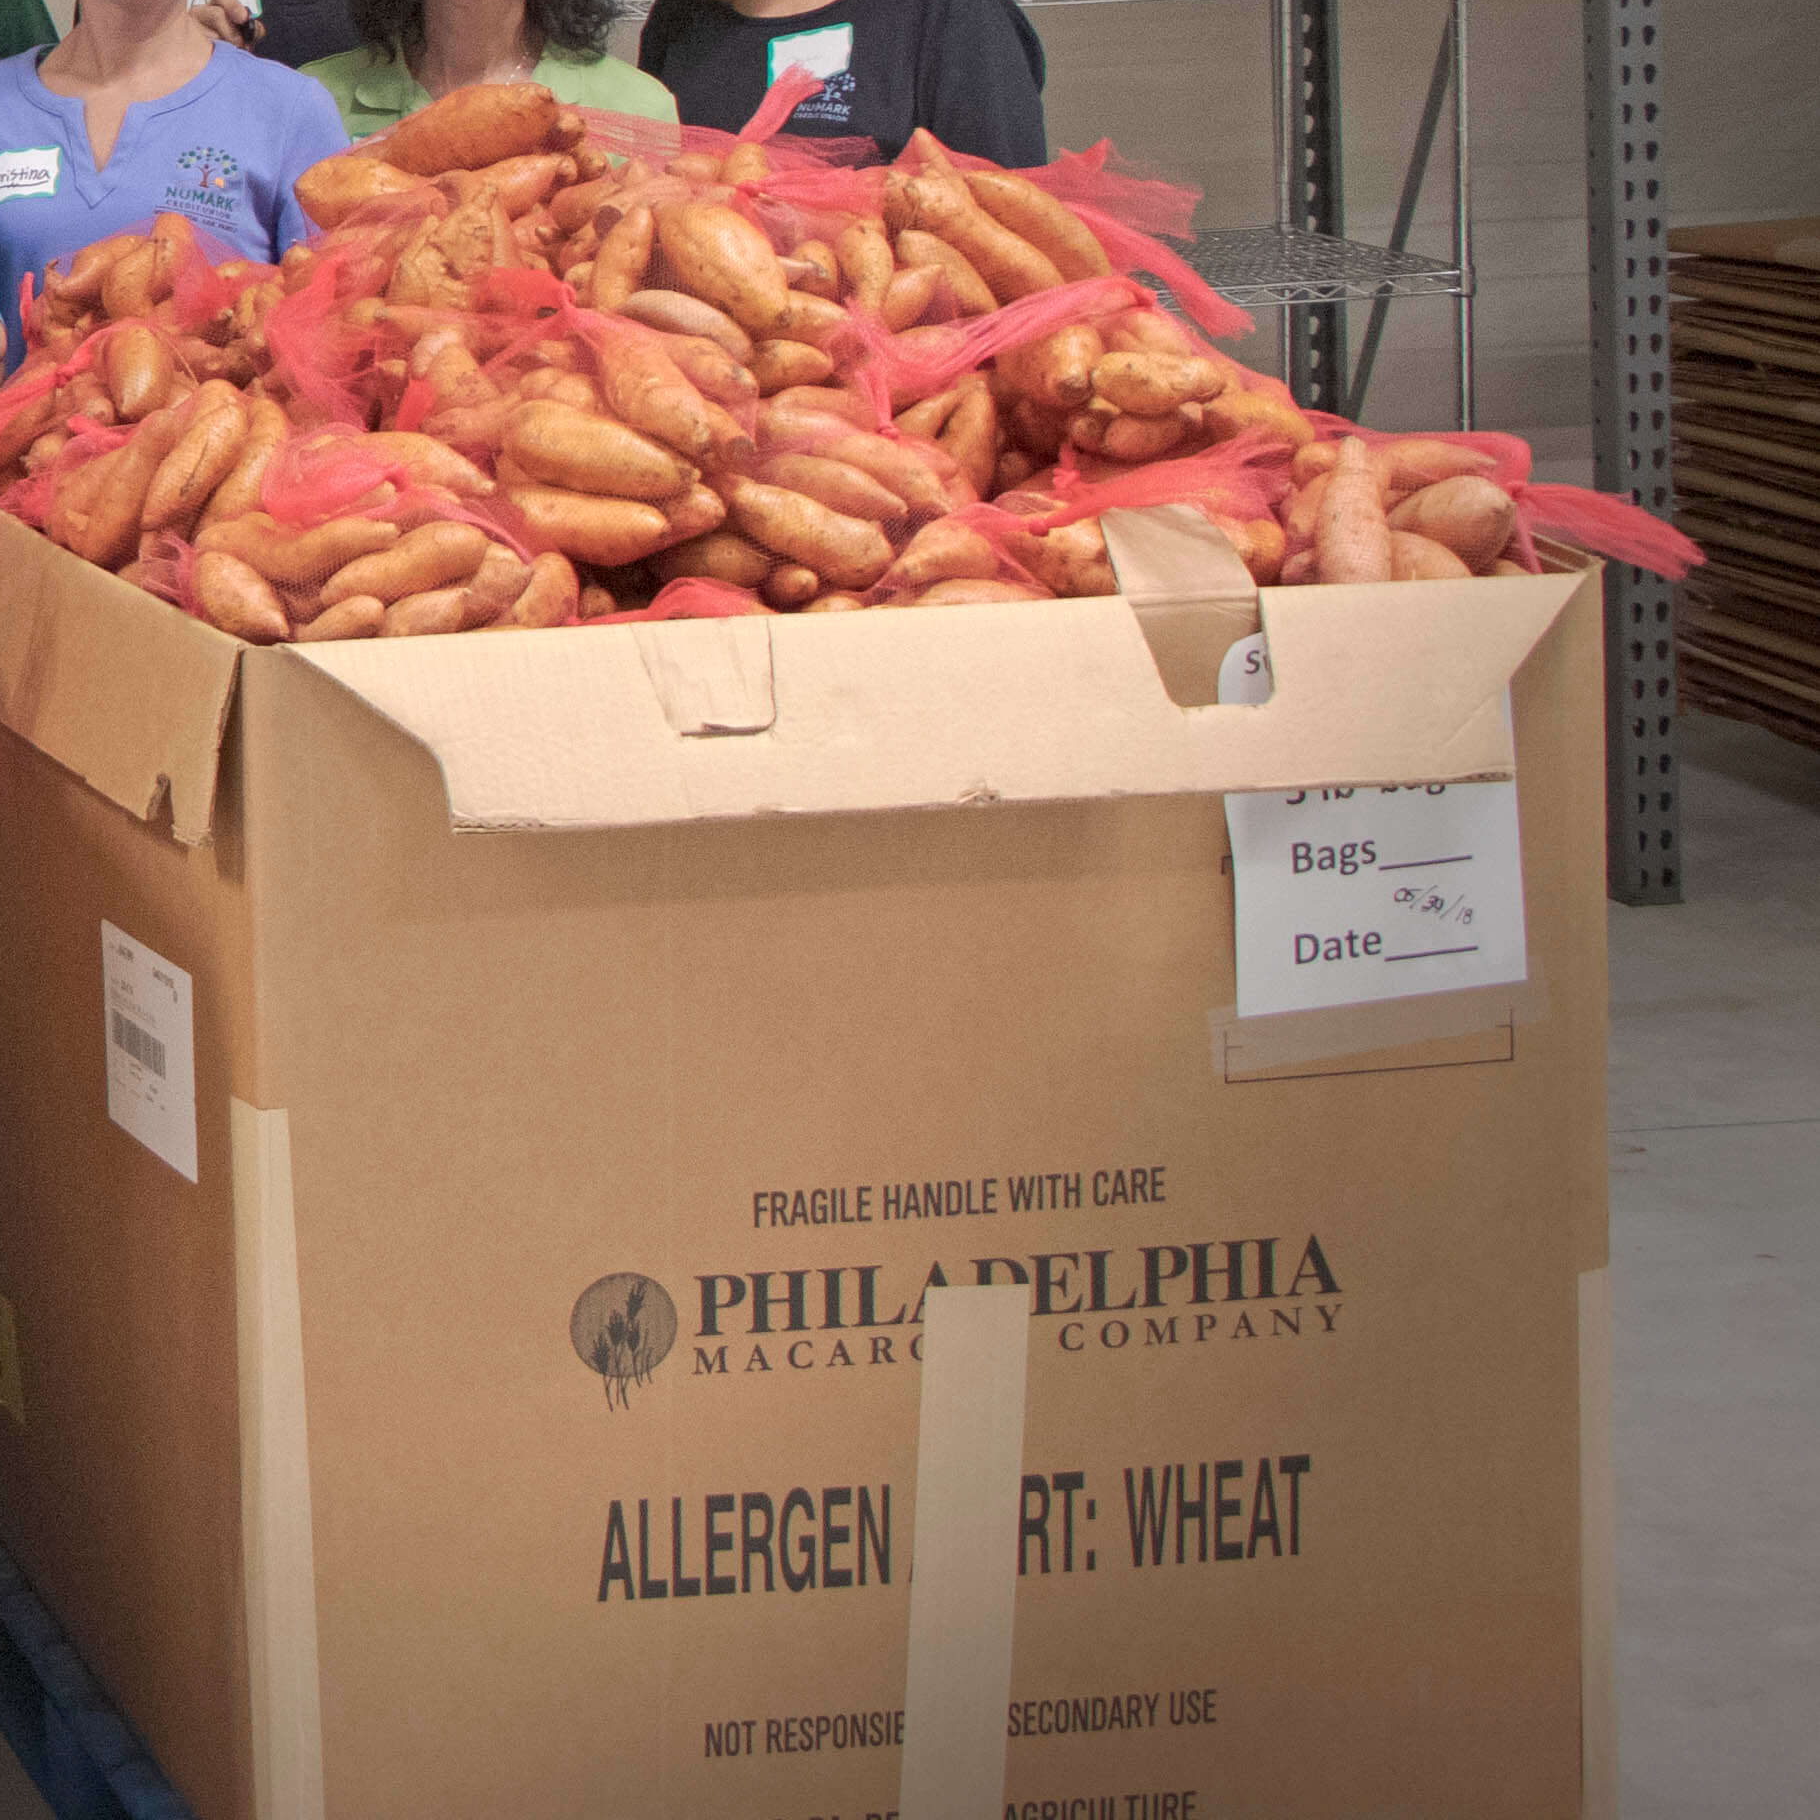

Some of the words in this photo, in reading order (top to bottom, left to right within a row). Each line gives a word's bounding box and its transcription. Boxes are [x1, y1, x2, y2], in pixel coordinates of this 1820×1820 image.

[796, 102, 852, 115] NUMARK
[165, 186, 235, 212] NUMARK
[1291, 839, 1377, 877] Bags
[1294, 928, 1383, 965] Date
[753, 1185, 873, 1228] FRAGILE
[881, 1180, 999, 1222] HANDLE
[1007, 1173, 1084, 1215] WITH
[1091, 1166, 1167, 1208] CARE
[1058, 1301, 1347, 1353] COMPANY
[597, 1482, 892, 1602] ALLERGEN
[1123, 1453, 1312, 1569] WHEAT
[704, 1719, 758, 1758] NOT
[1006, 1693, 1161, 1737] SECONDARY
[1168, 1689, 1218, 1725] USE
